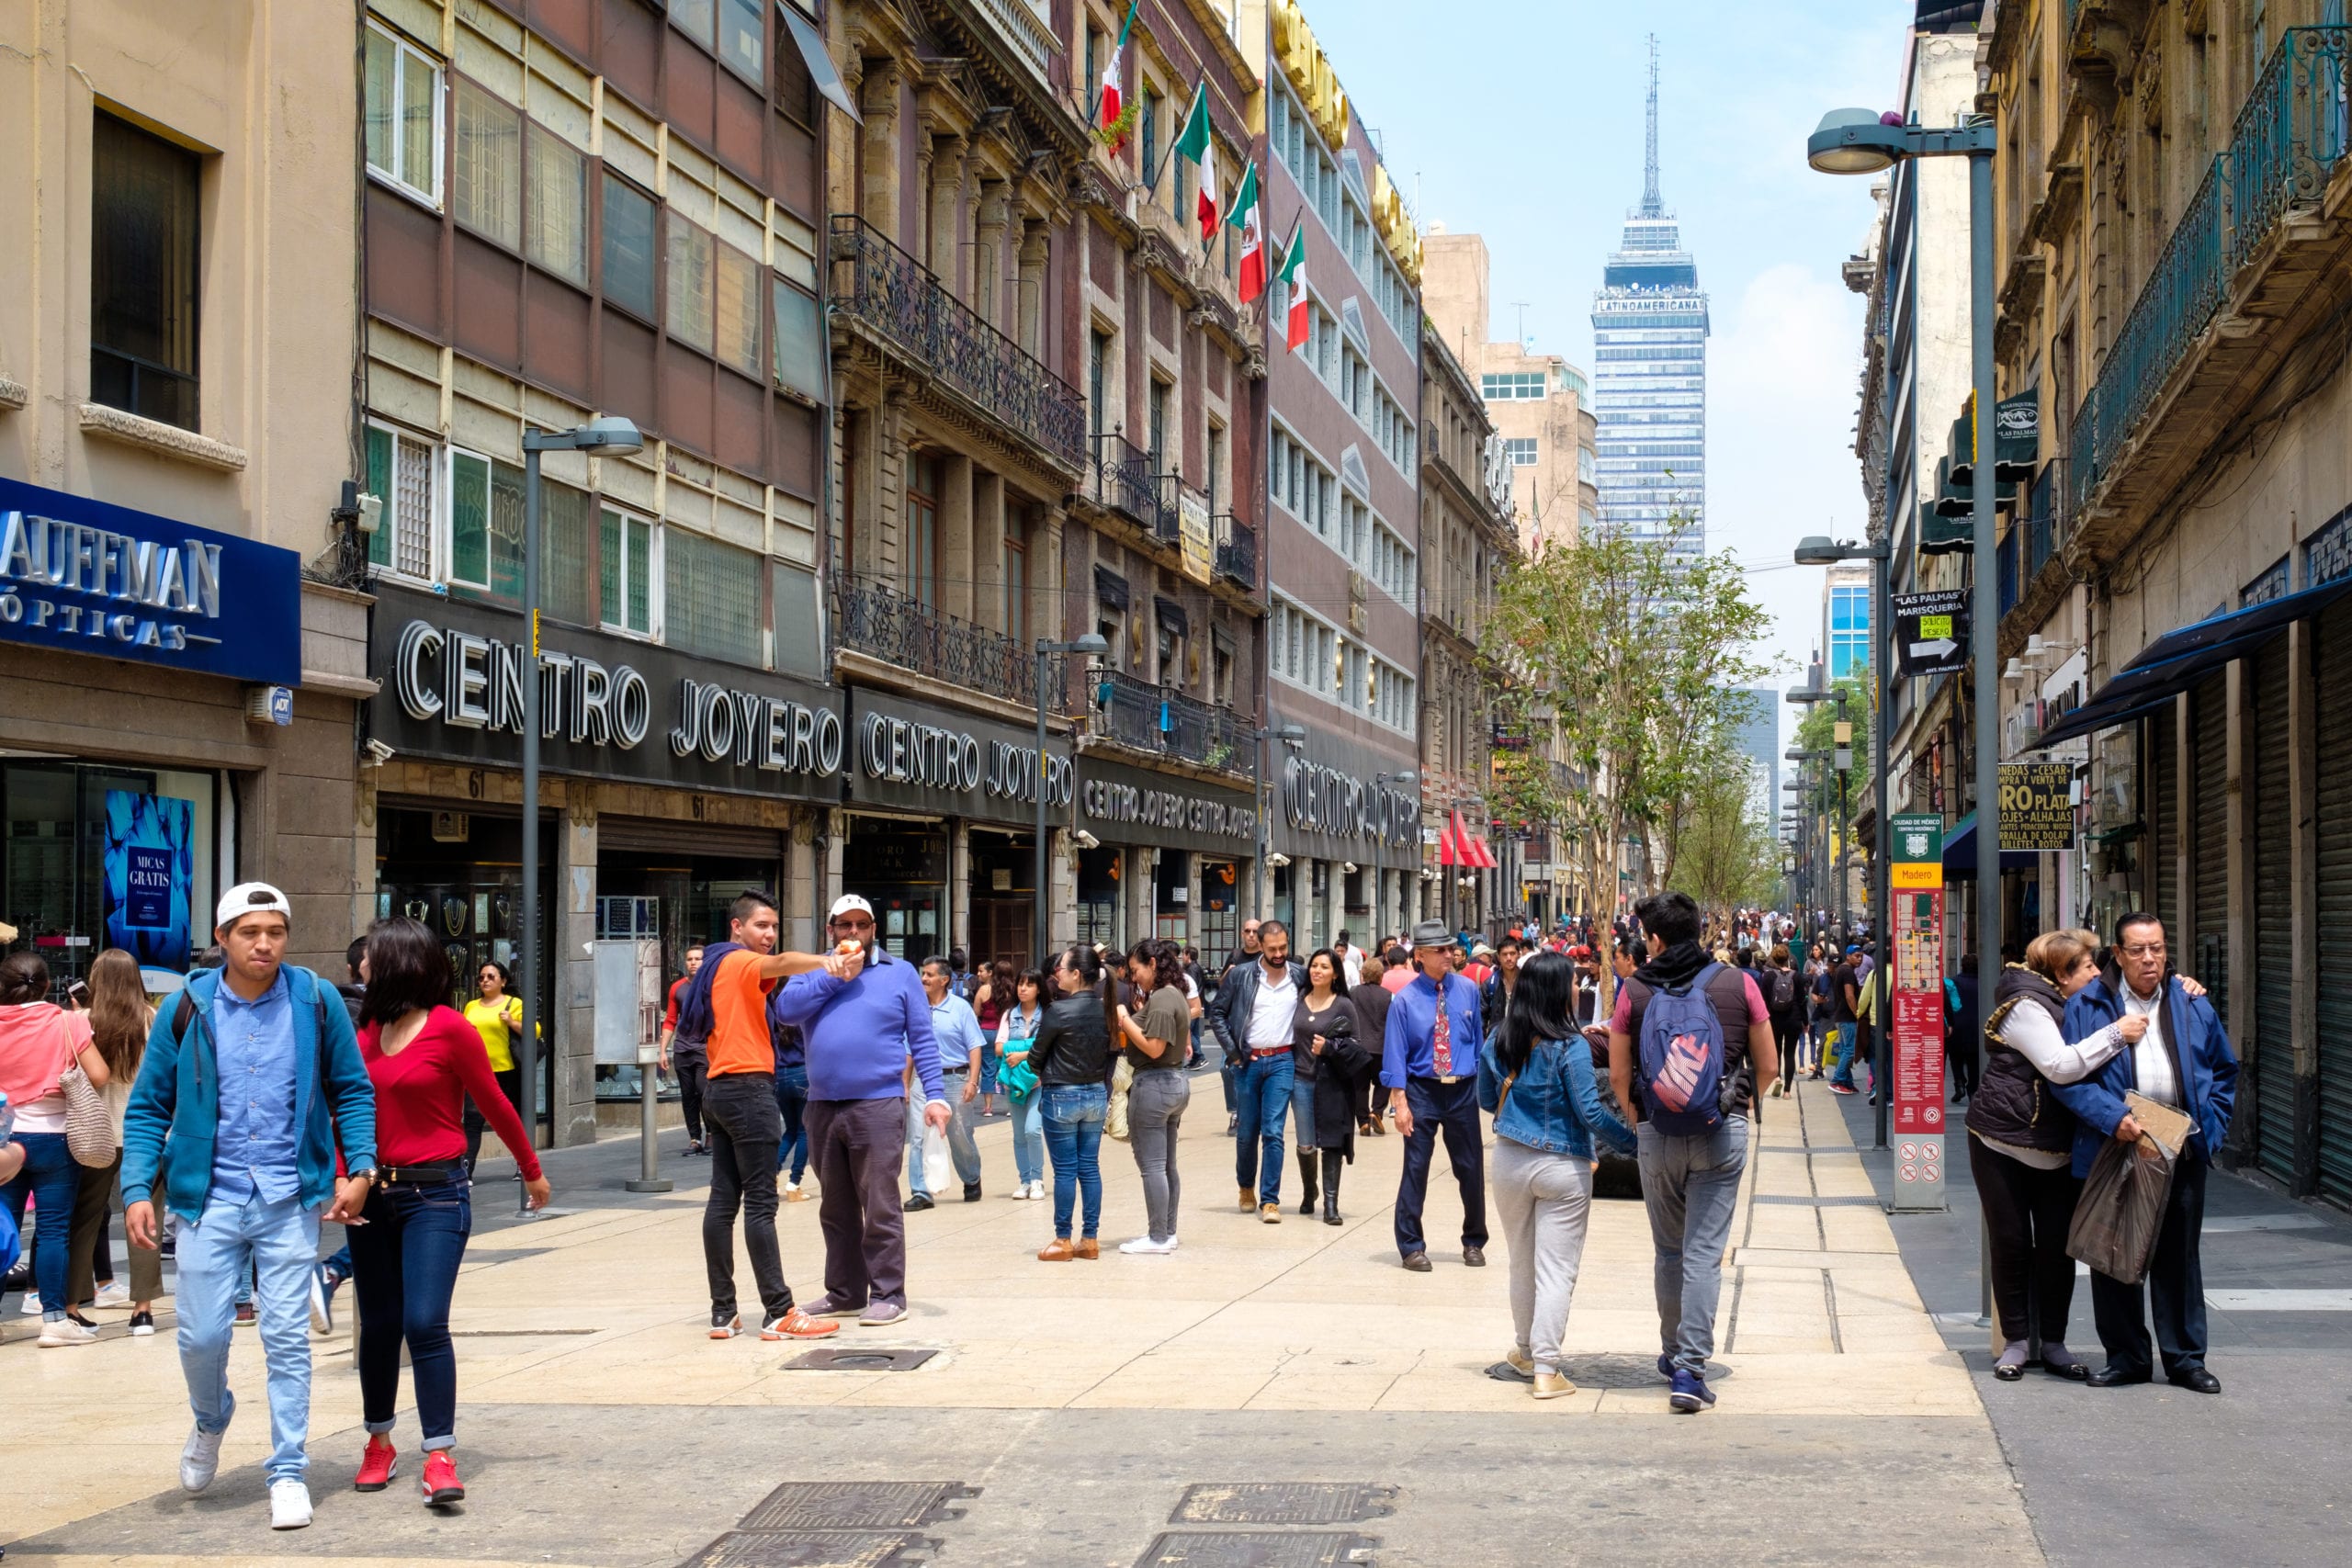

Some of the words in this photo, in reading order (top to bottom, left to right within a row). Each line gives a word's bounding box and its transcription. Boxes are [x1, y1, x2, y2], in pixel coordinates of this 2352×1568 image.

[1600, 300, 1698, 311] LATINOAMERICANA
[0, 511, 223, 618] AUFFMAN
[1897, 603, 1963, 616] MARISQUERIA
[1922, 617, 1951, 626] SOLICITO
[275, 697, 289, 712] ADT
[396, 619, 650, 750] CENTRO
[669, 677, 842, 778] JOYERO
[862, 711, 979, 793] CENTRO
[469, 770, 485, 799] 61
[2022, 776, 2028, 784] Y
[2030, 775, 2054, 784] VENTA
[2058, 775, 2067, 784] DE
[2049, 783, 2055, 795] Y
[1284, 756, 1364, 840] CENTRO
[1363, 781, 1421, 850] JOYERO
[1997, 784, 2033, 810] RO
[692, 794, 705, 821] 61
[1083, 779, 1139, 823] CENTRO
[1139, 788, 1185, 829] JOYERO
[1187, 797, 1226, 835] CENTRO
[1226, 805, 1256, 840] JOYER
[2030, 811, 2072, 822] ALHAJAS
[2031, 831, 2040, 840] DE
[2042, 830, 2068, 840] DOLAR
[2001, 840, 2034, 849] BILLETES
[2038, 840, 2064, 849] ROTOS
[137, 855, 165, 870] MICAS
[130, 870, 169, 887] GRATIS
[1902, 869, 1932, 880] Madero
[1652, 1033, 1709, 1113] NIKE
